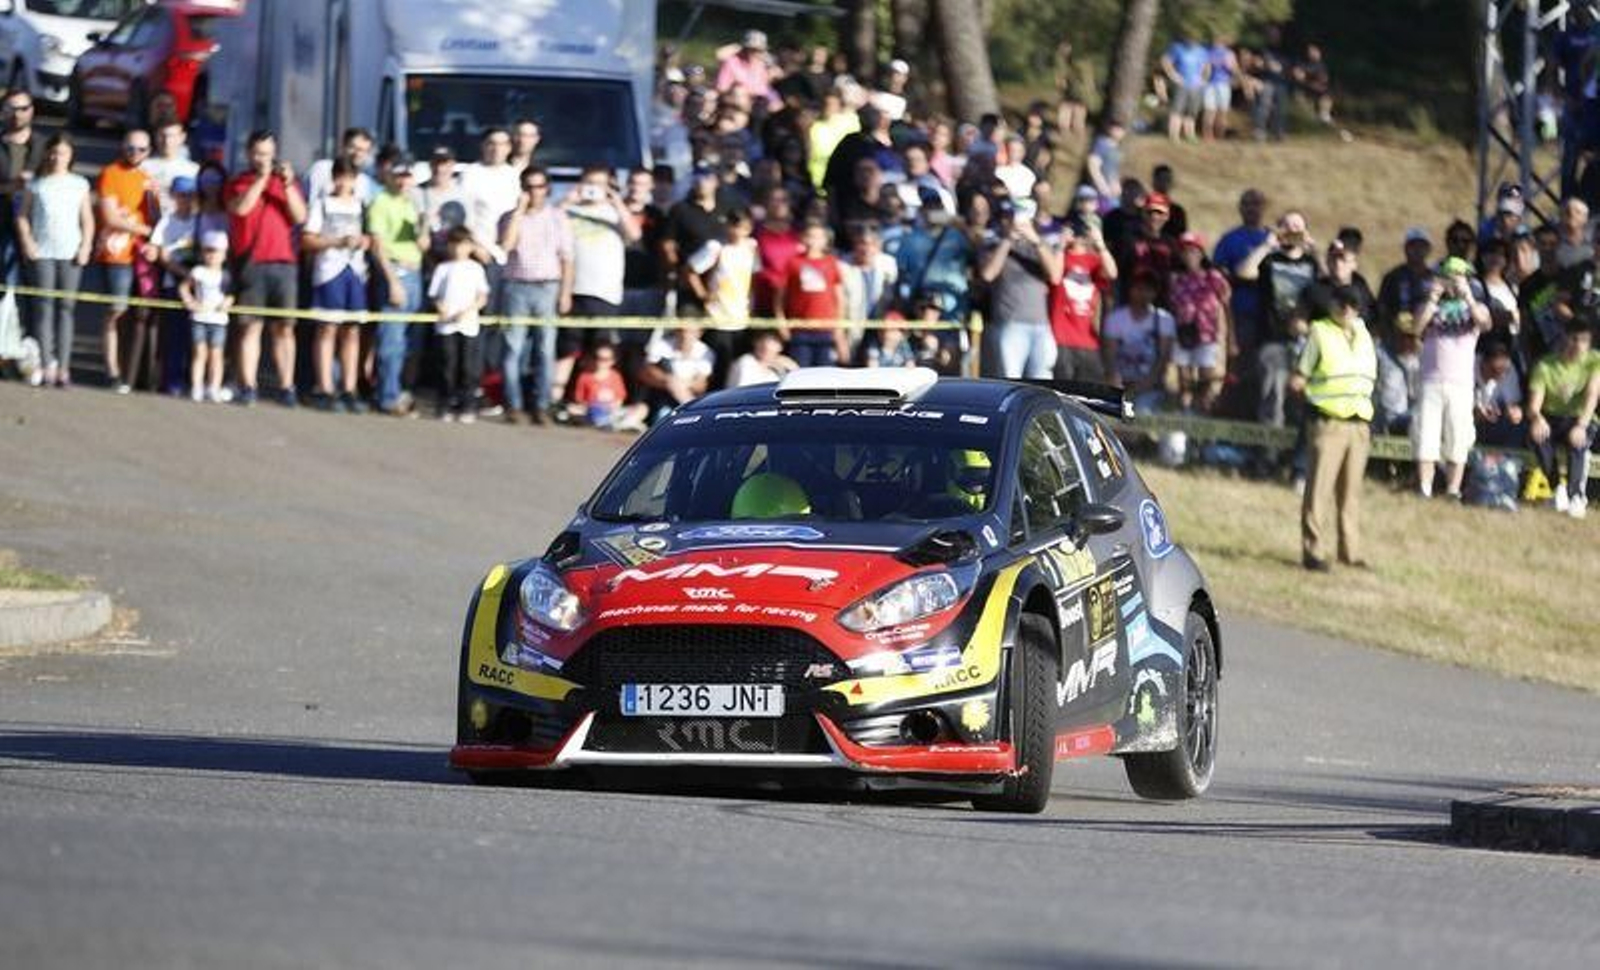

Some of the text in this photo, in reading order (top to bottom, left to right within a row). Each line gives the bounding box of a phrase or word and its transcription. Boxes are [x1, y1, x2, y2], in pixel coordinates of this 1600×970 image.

[599, 602, 818, 622] machines made for racing
[479, 663, 515, 686] RACC
[935, 665, 981, 689] ACC
[642, 686, 711, 711] 1236
[722, 686, 774, 711] JNT
